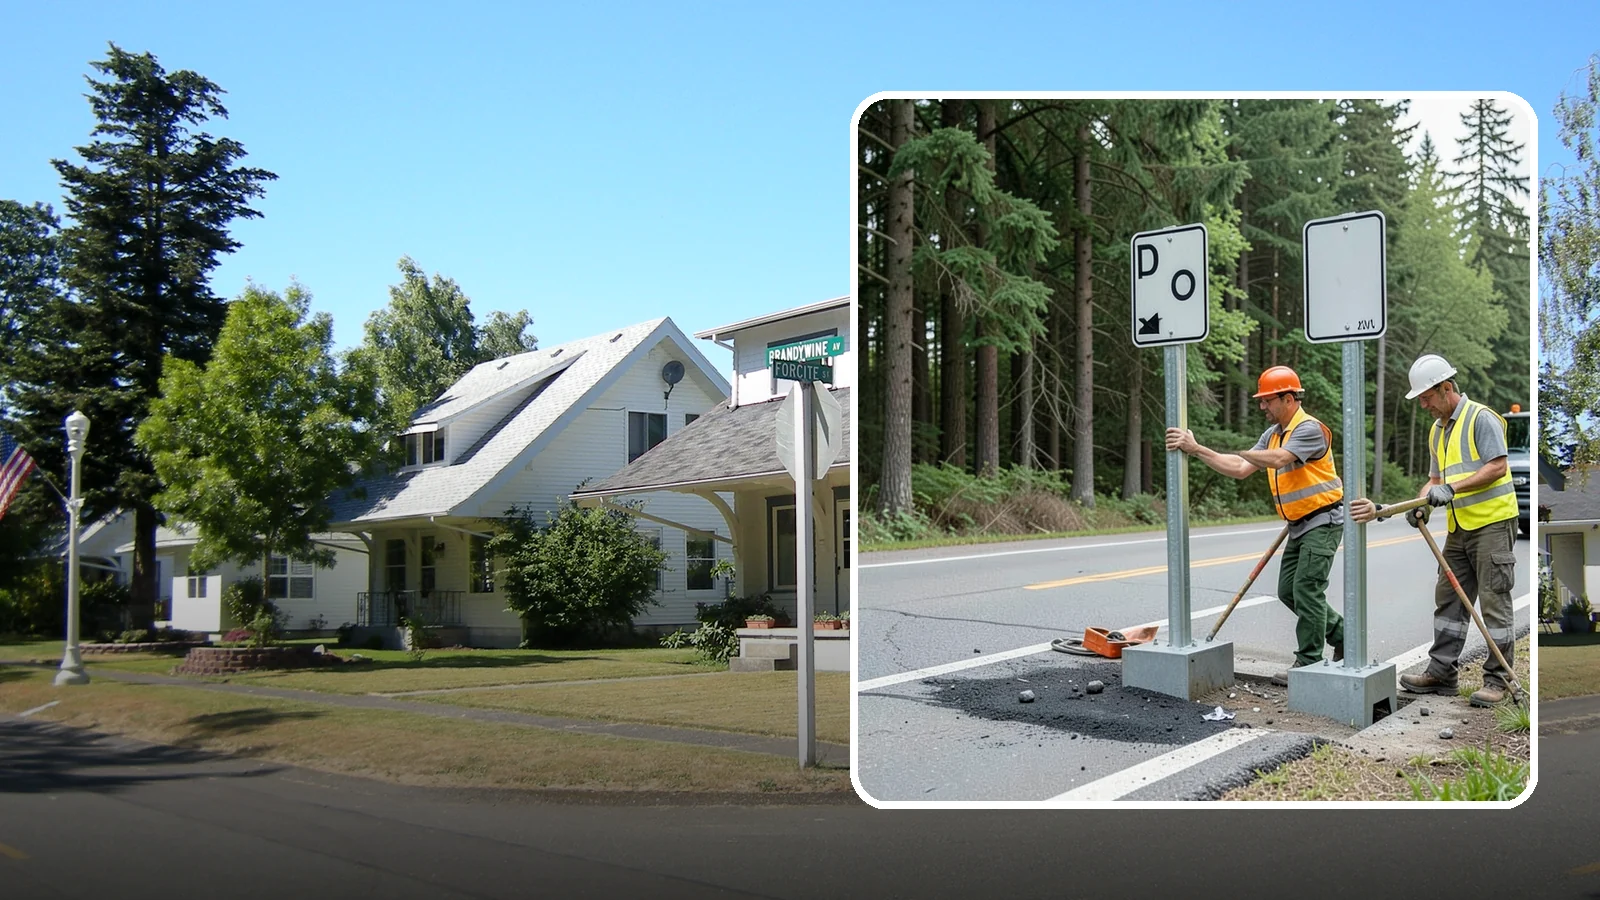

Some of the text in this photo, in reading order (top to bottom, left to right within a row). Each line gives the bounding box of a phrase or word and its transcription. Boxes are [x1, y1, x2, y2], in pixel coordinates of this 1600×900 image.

[769, 341, 841, 364] BRANDYWINE AV
[775, 362, 819, 380] FORCITE
